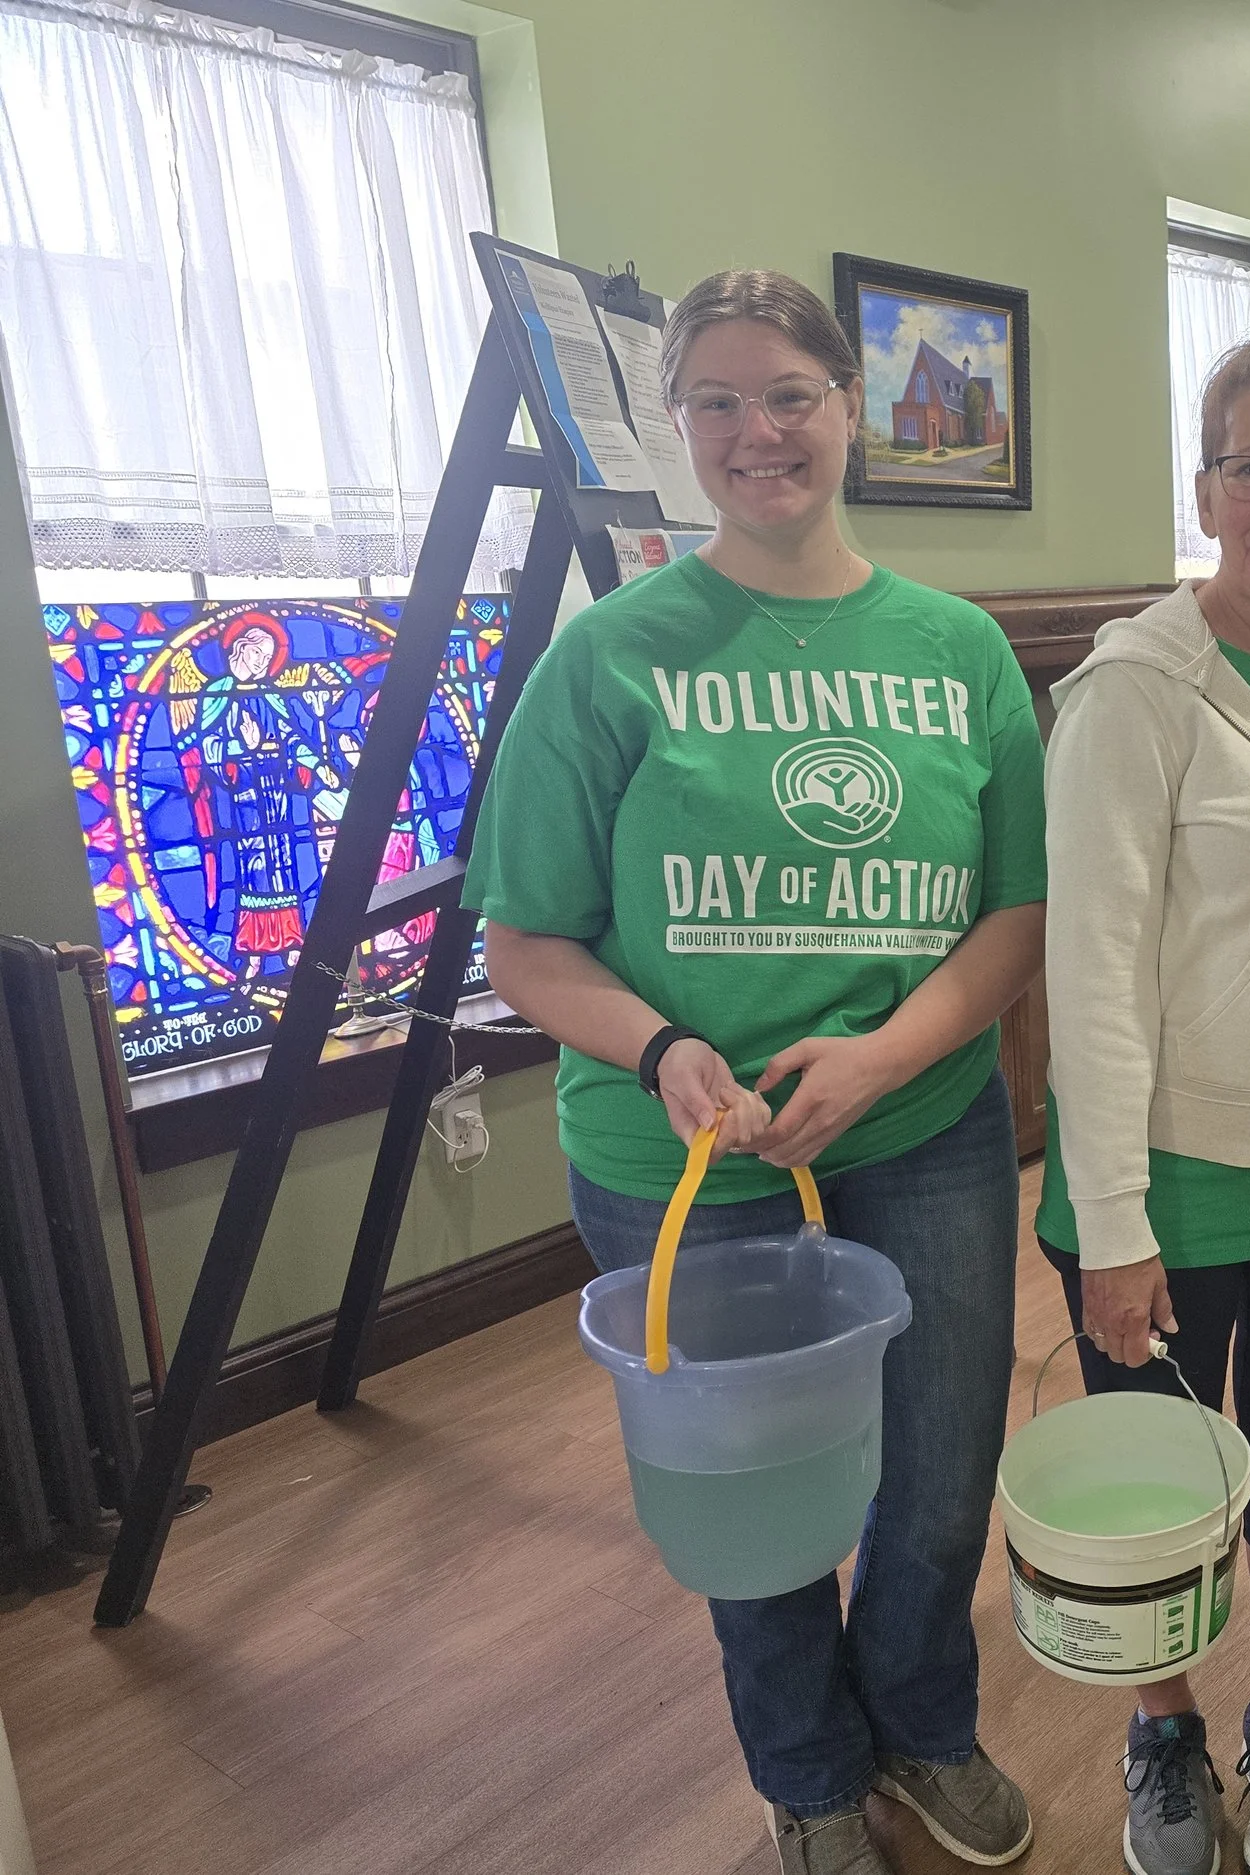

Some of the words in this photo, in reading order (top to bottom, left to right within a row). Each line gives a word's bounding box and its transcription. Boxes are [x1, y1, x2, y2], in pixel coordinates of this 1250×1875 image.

[652, 666, 970, 745] VOLUNTEER
[663, 854, 767, 918] DAY
[780, 866, 817, 904] OF
[825, 857, 975, 924] ACTION
[672, 931, 728, 947] BROUGHT
[730, 932, 745, 947] TO
[748, 932, 773, 947] YOU
[776, 932, 792, 947] BY
[795, 932, 883, 949] SUSQUEHANNA
[122, 1030, 184, 1061] GLORY
[191, 1024, 216, 1045] OF
[223, 1015, 262, 1038] GOD
